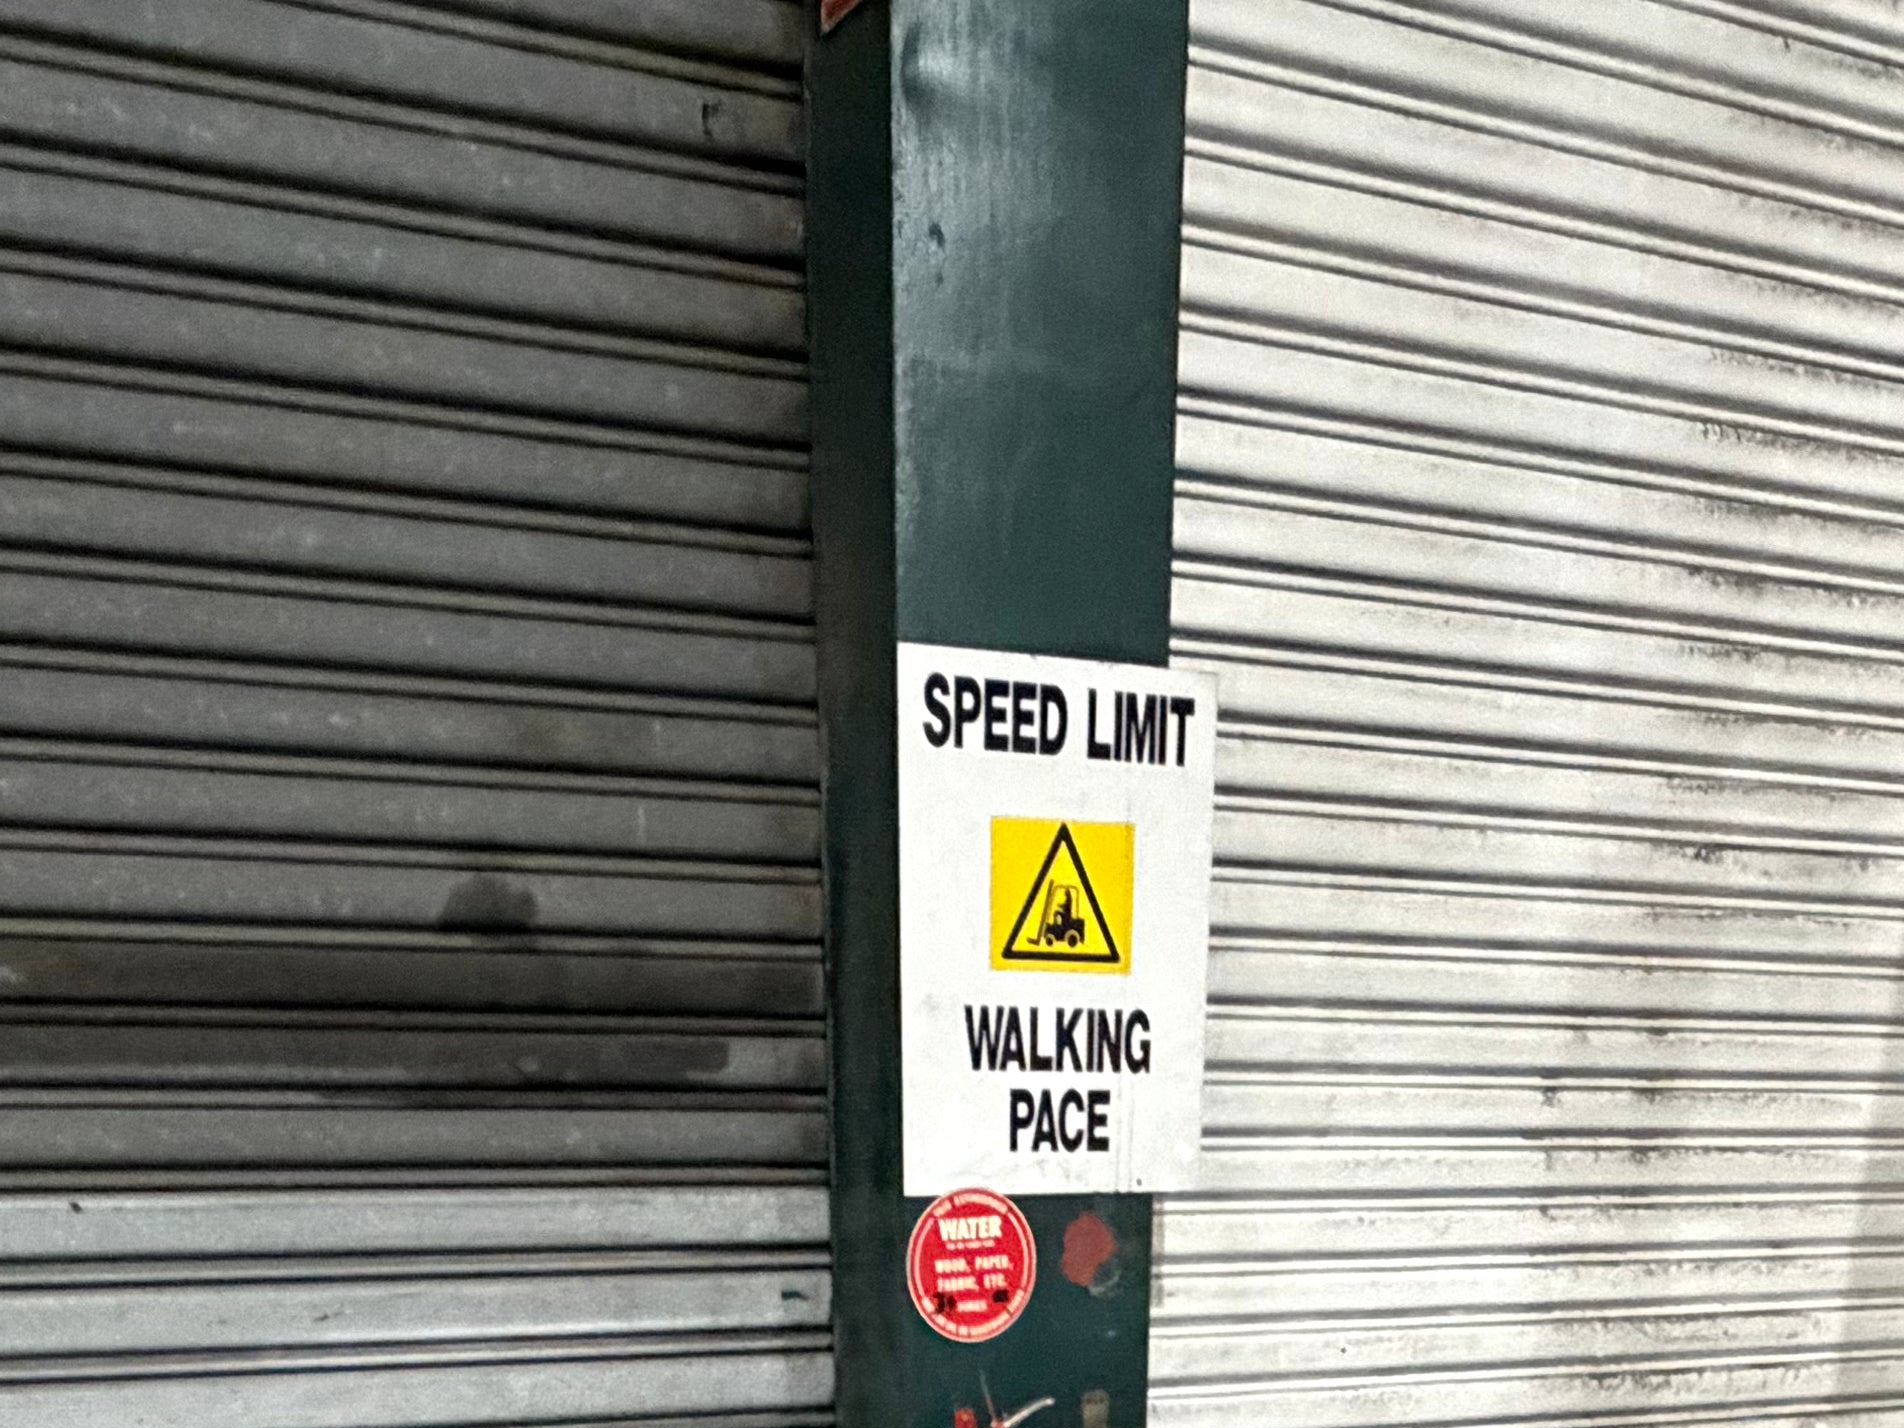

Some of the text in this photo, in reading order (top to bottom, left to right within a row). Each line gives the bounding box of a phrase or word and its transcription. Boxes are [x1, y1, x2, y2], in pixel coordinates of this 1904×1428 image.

[923, 672, 1195, 767] SPEED LIMIT
[964, 1004, 1151, 1074] WALKING
[1010, 1088, 1111, 1153] PACE
[938, 1215, 1002, 1241] WATER
